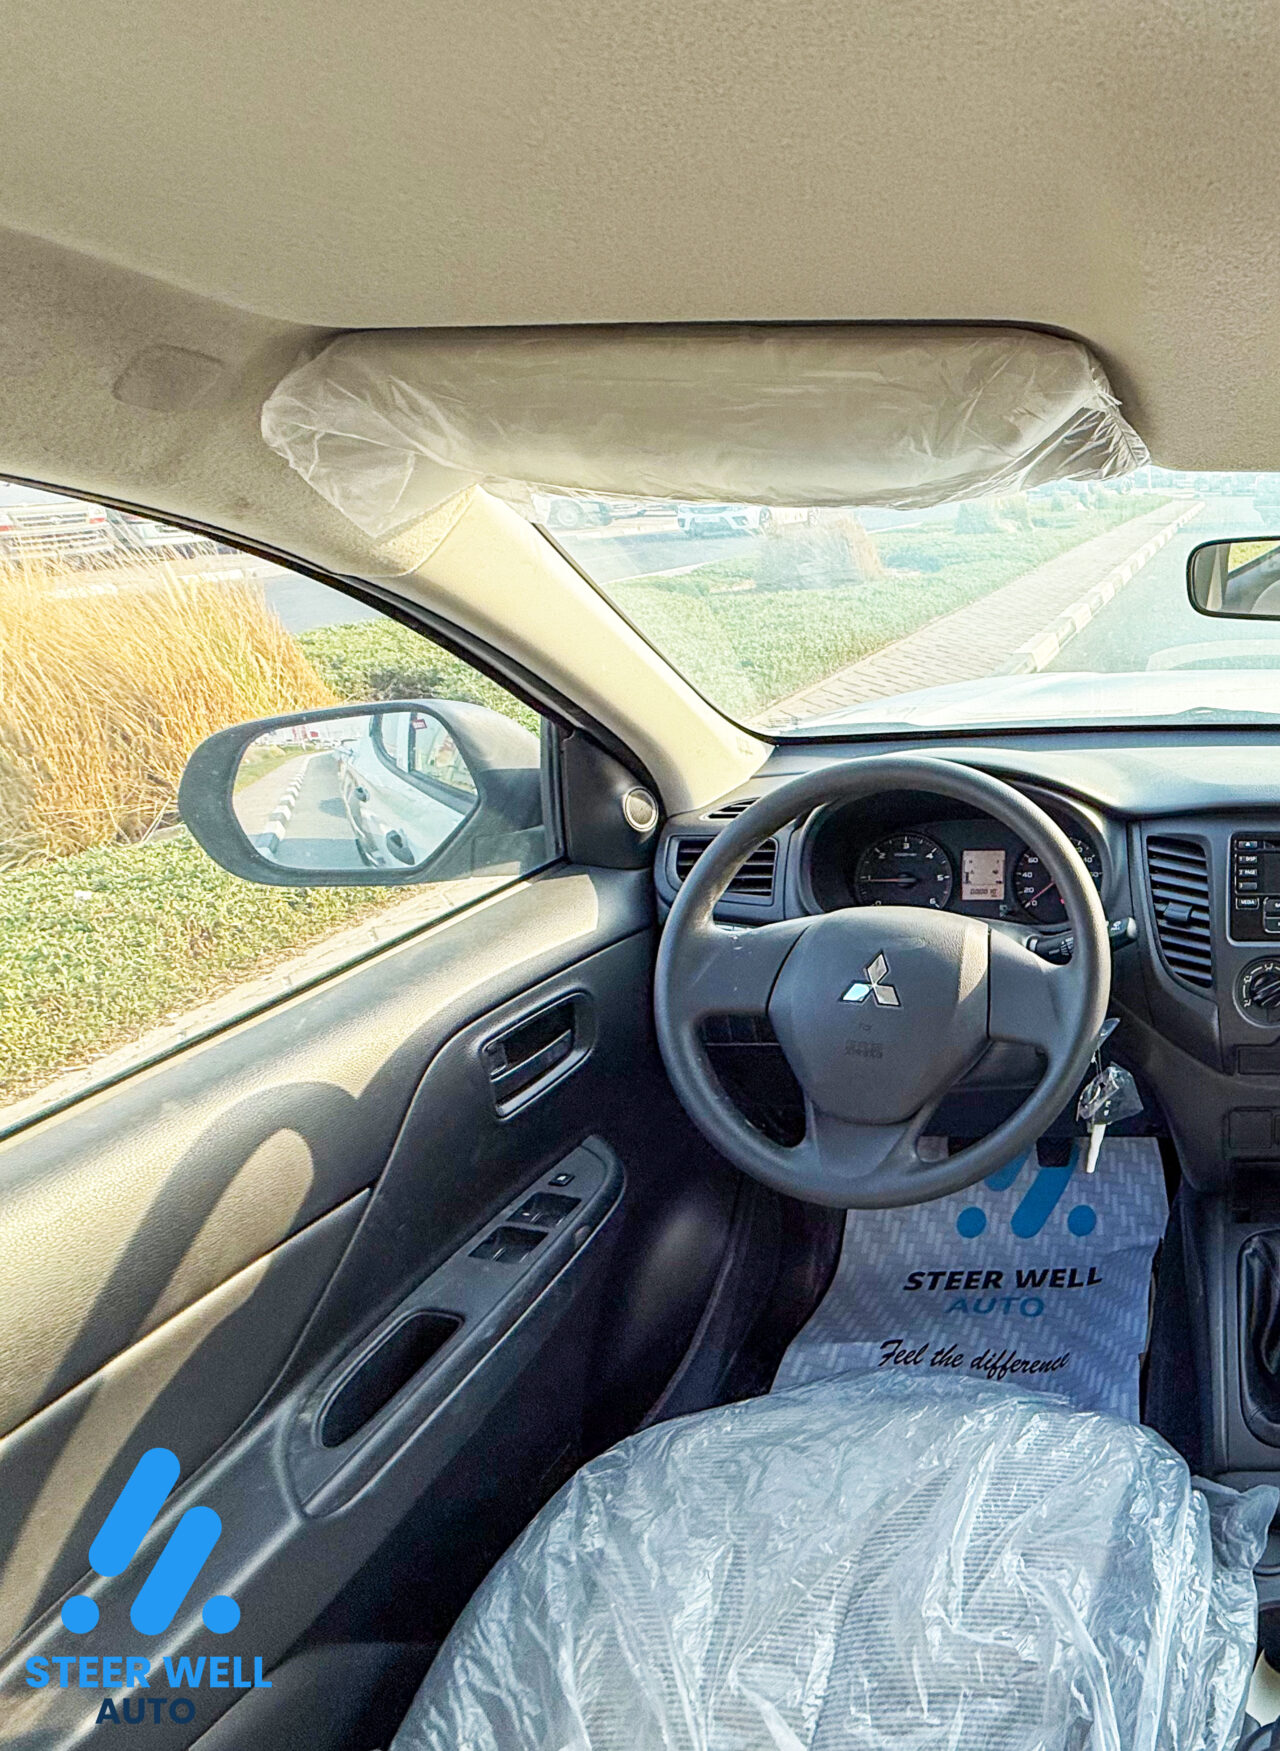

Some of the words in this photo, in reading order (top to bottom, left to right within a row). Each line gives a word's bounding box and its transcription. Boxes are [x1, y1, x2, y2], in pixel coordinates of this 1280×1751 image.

[902, 842, 910, 850] 3
[936, 874, 944, 882] 5
[929, 897, 937, 905] 6
[903, 1270, 1002, 1291] STEER
[1015, 1266, 1103, 1289] WELL
[944, 1296, 1046, 1318] AUTO
[878, 1339, 929, 1367] Feel
[930, 1343, 963, 1369] the
